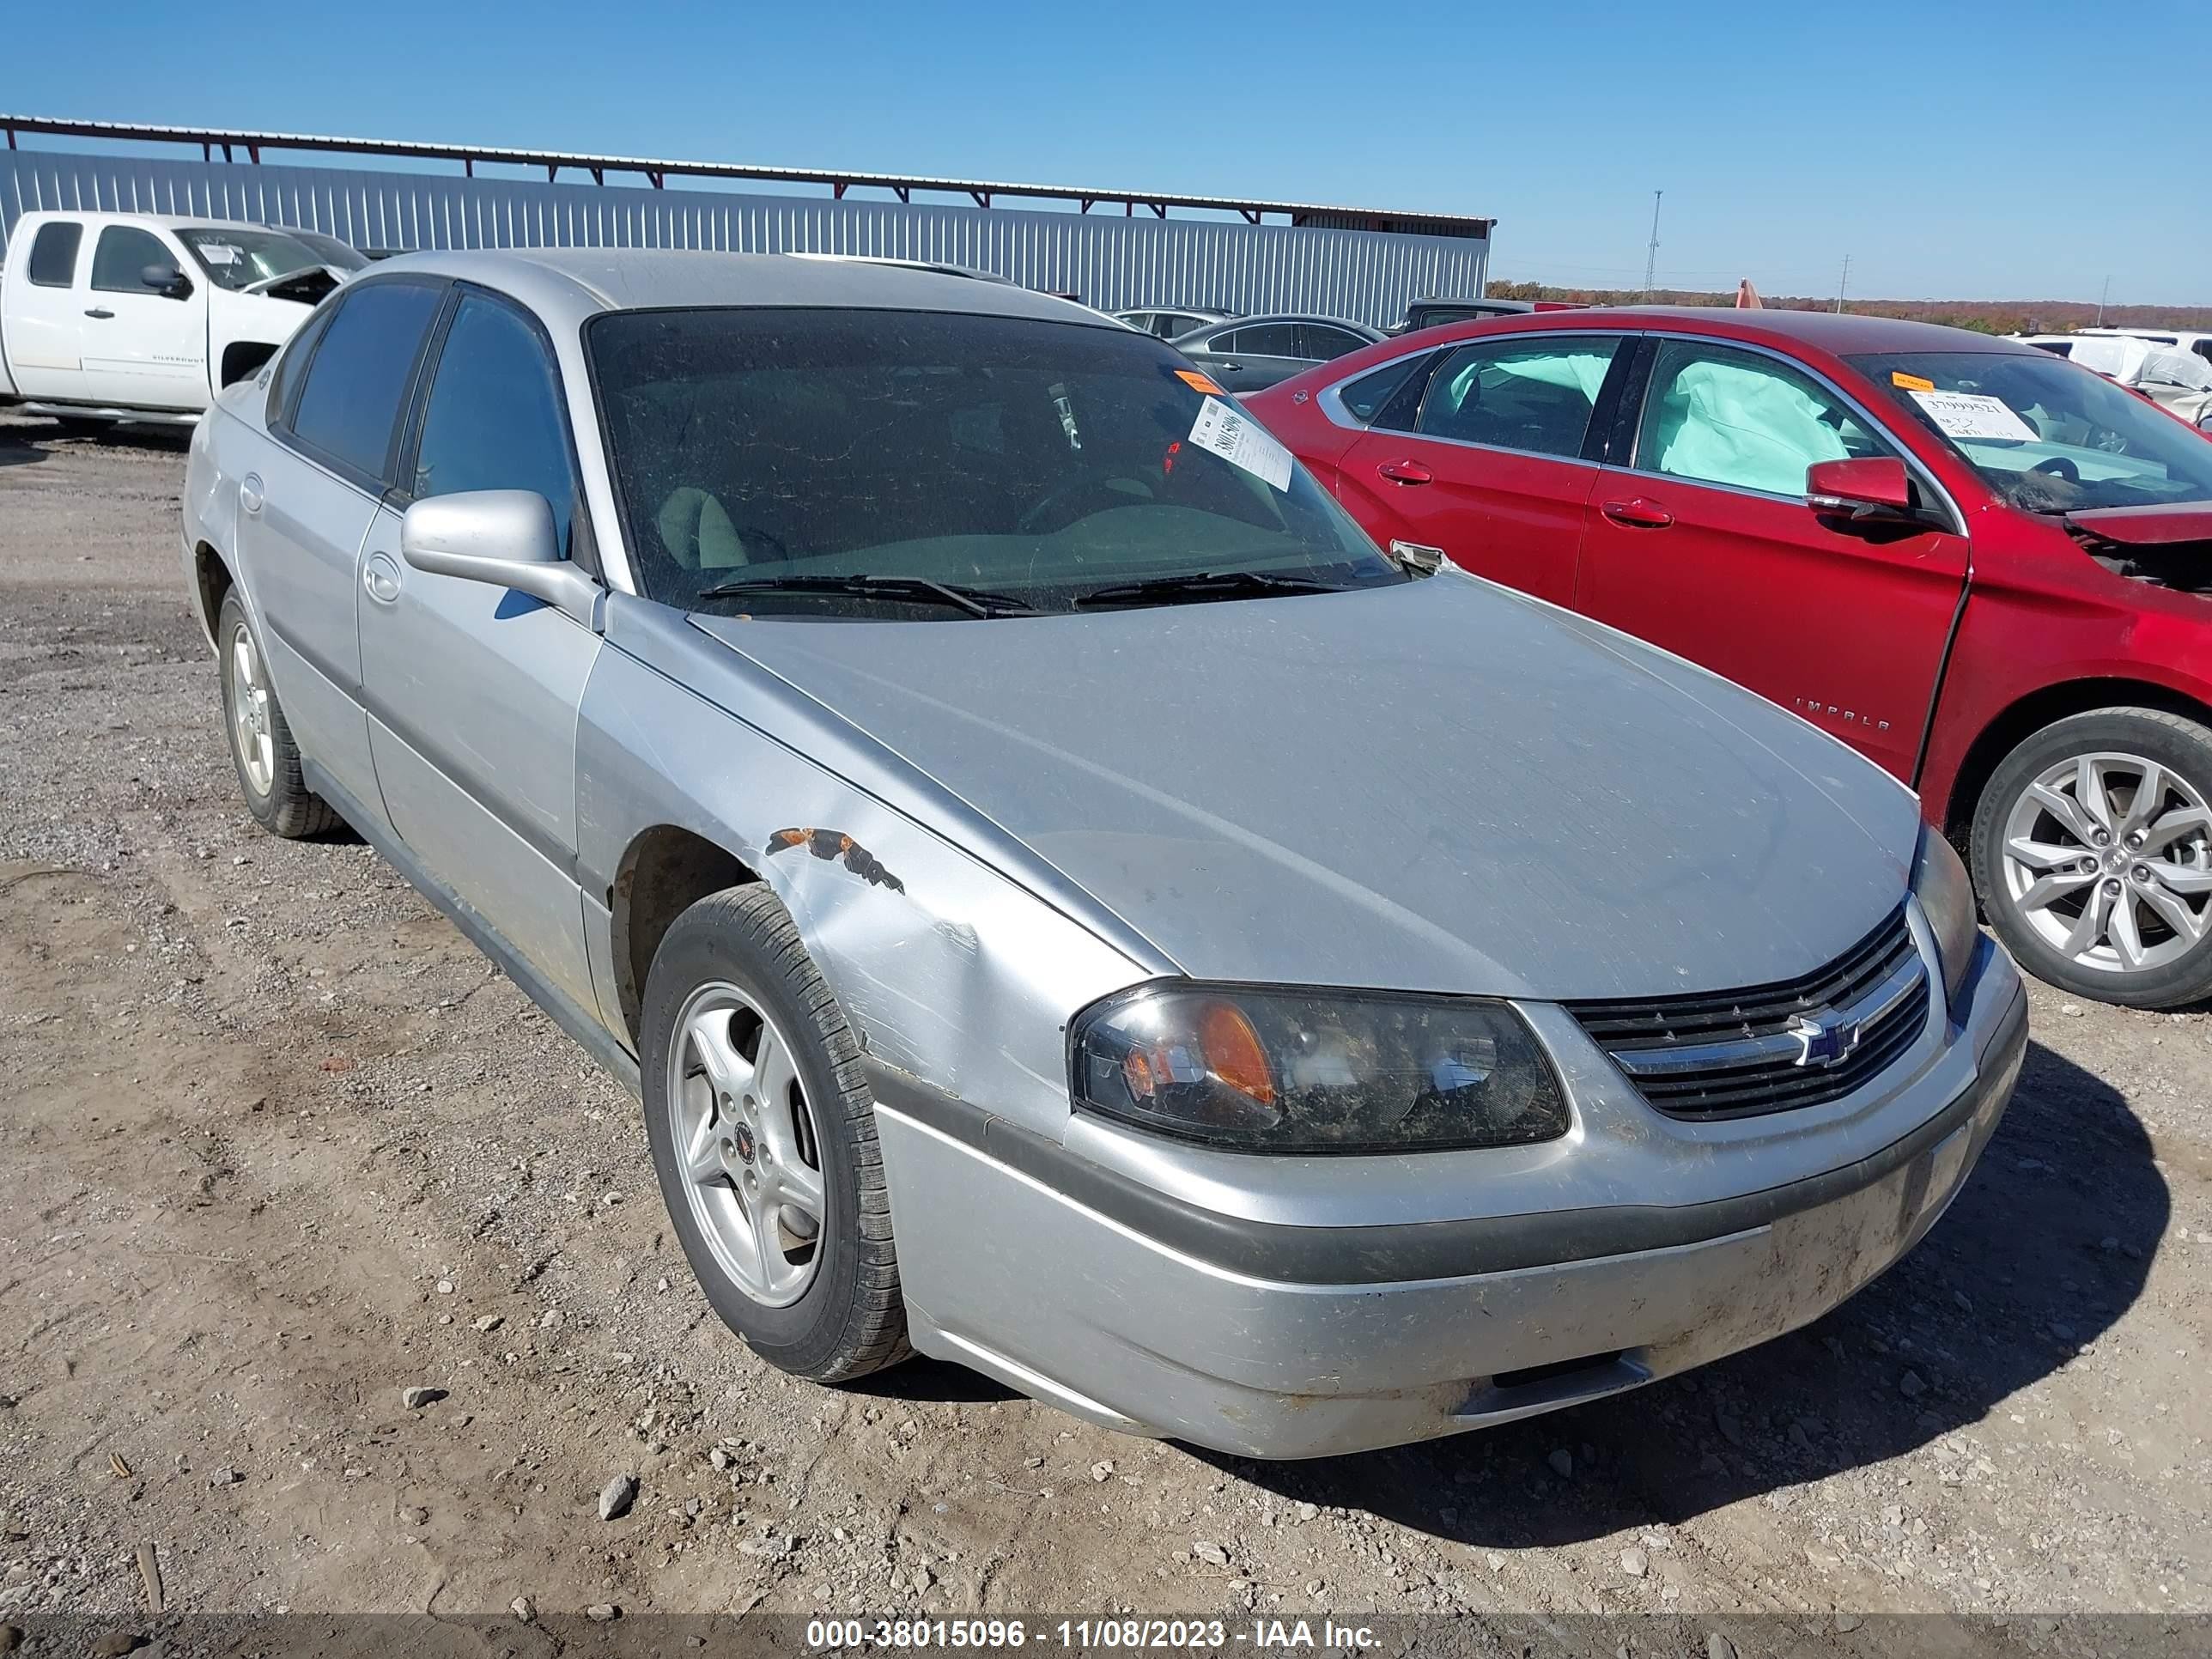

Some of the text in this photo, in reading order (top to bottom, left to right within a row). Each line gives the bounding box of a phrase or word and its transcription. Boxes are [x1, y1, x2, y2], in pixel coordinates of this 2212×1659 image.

[1927, 400, 2002, 414] 37999521
[1213, 411, 1243, 455] 38015096
[1795, 697, 1890, 730] IMPALA
